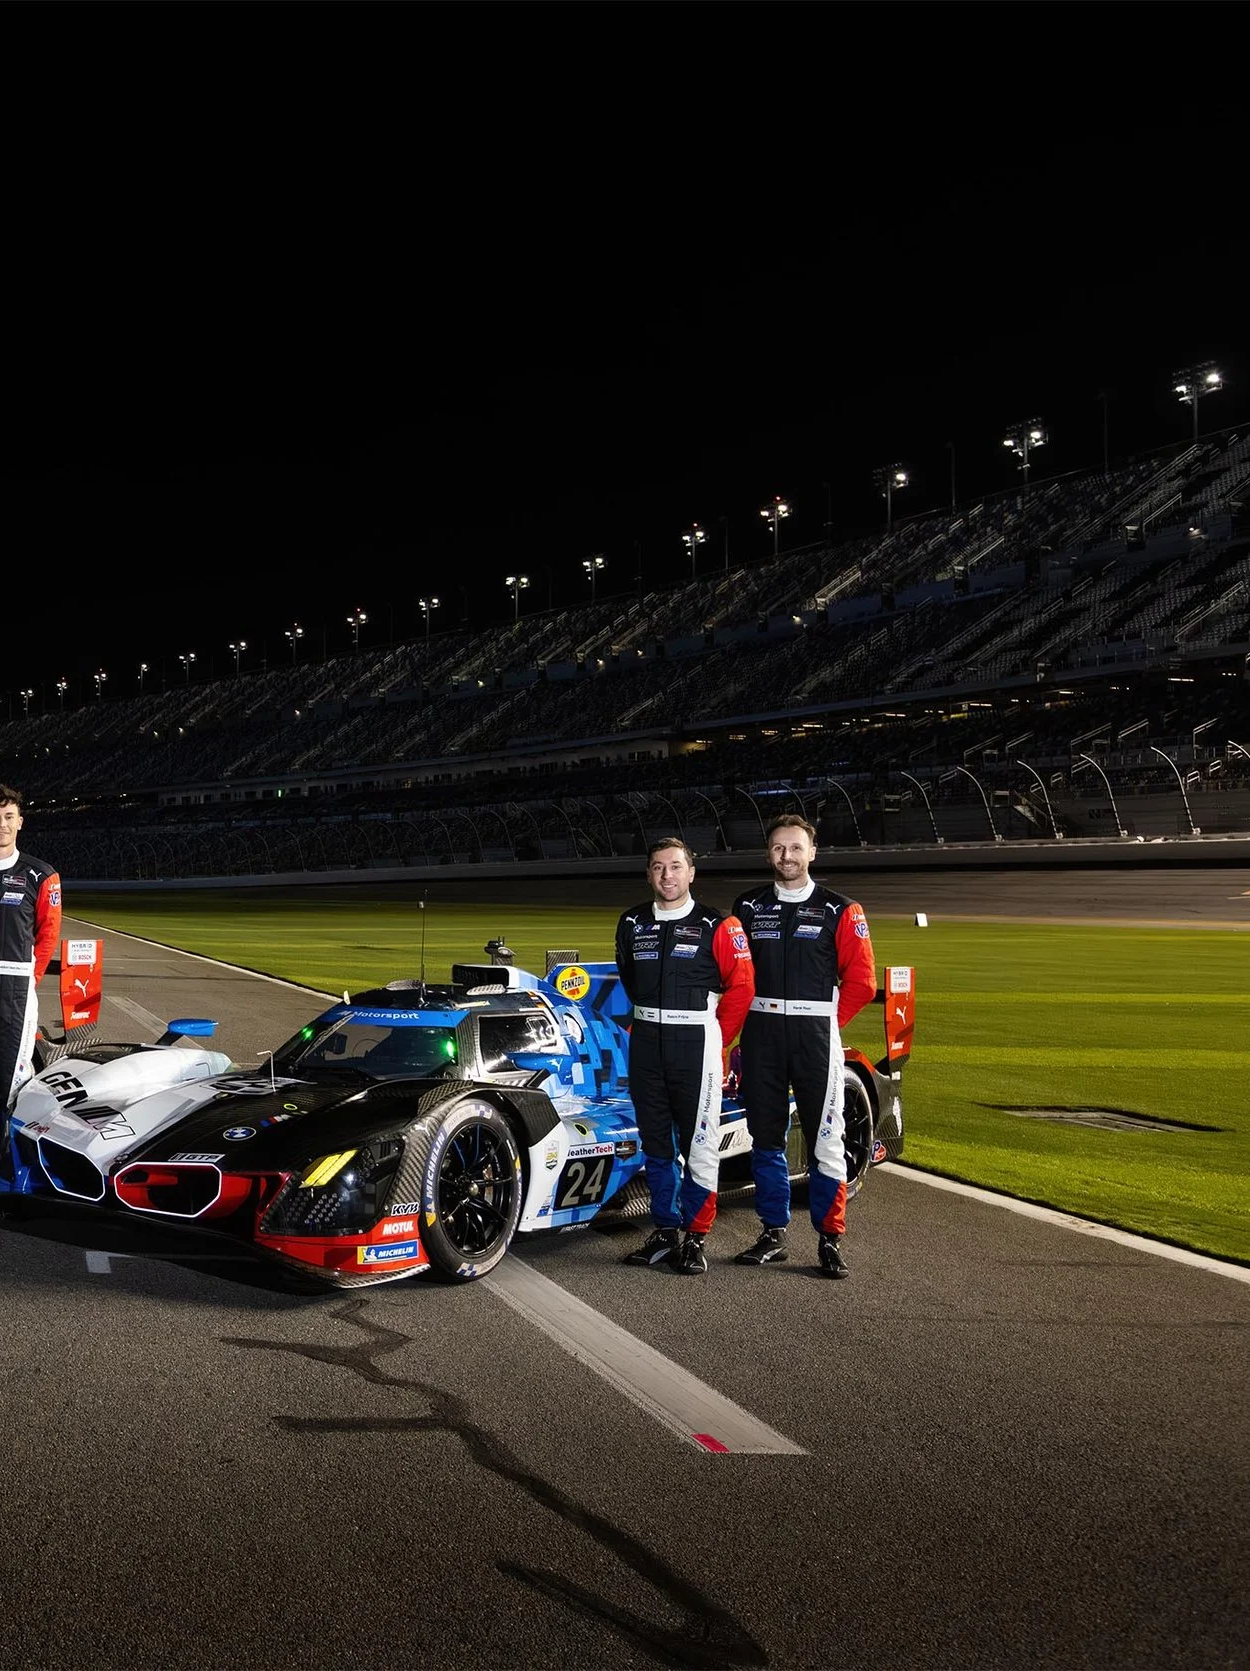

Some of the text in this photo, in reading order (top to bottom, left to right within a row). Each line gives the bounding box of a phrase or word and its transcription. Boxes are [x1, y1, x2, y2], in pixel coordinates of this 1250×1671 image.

[561, 976, 585, 991] PENNZOIL
[353, 1010, 420, 1020] Motorsport
[39, 1071, 89, 1109] GEN
[703, 1072, 713, 1113] Motorsport
[567, 1145, 613, 1157] eatherTech
[425, 1132, 446, 1200] MICHELIN
[560, 1158, 606, 1207] 24
[391, 1202, 419, 1216] KYB
[382, 1220, 414, 1235] MOTUL
[377, 1246, 414, 1258] MICHELIN
